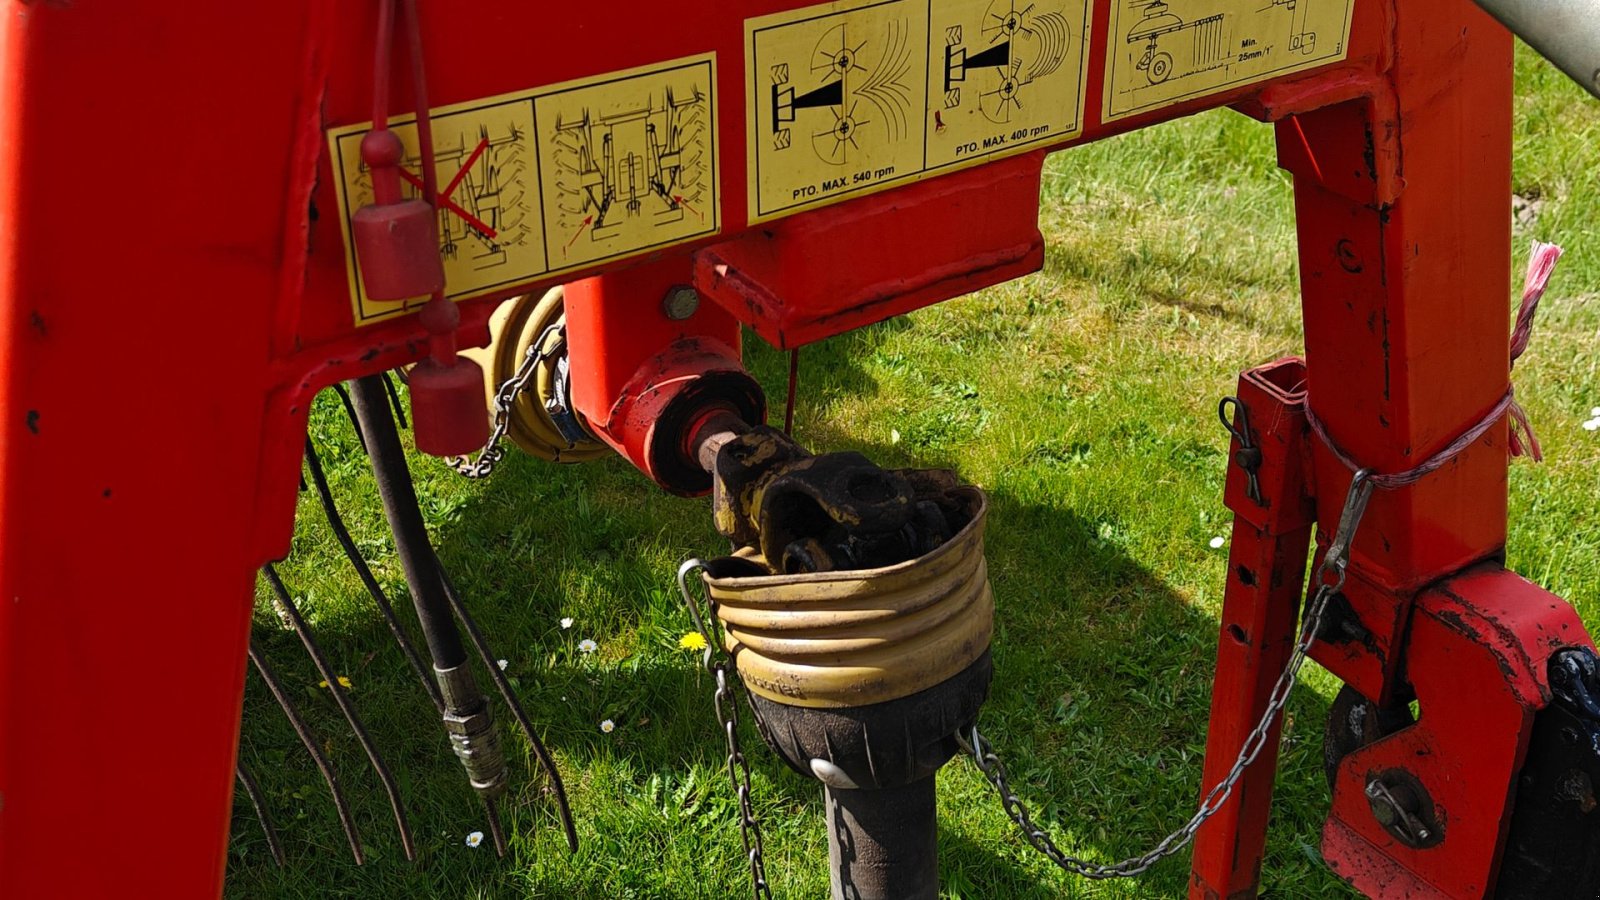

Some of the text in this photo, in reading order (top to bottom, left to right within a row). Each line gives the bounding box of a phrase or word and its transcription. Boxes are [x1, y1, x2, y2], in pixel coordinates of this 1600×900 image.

[1241, 39, 1257, 48] Min.
[955, 142, 979, 156] PTO.
[983, 134, 1008, 149] MAX.
[1010, 128, 1028, 141] 400
[1030, 124, 1049, 137] rpm
[793, 166, 895, 200] PTO. MAX. 540 rpm
